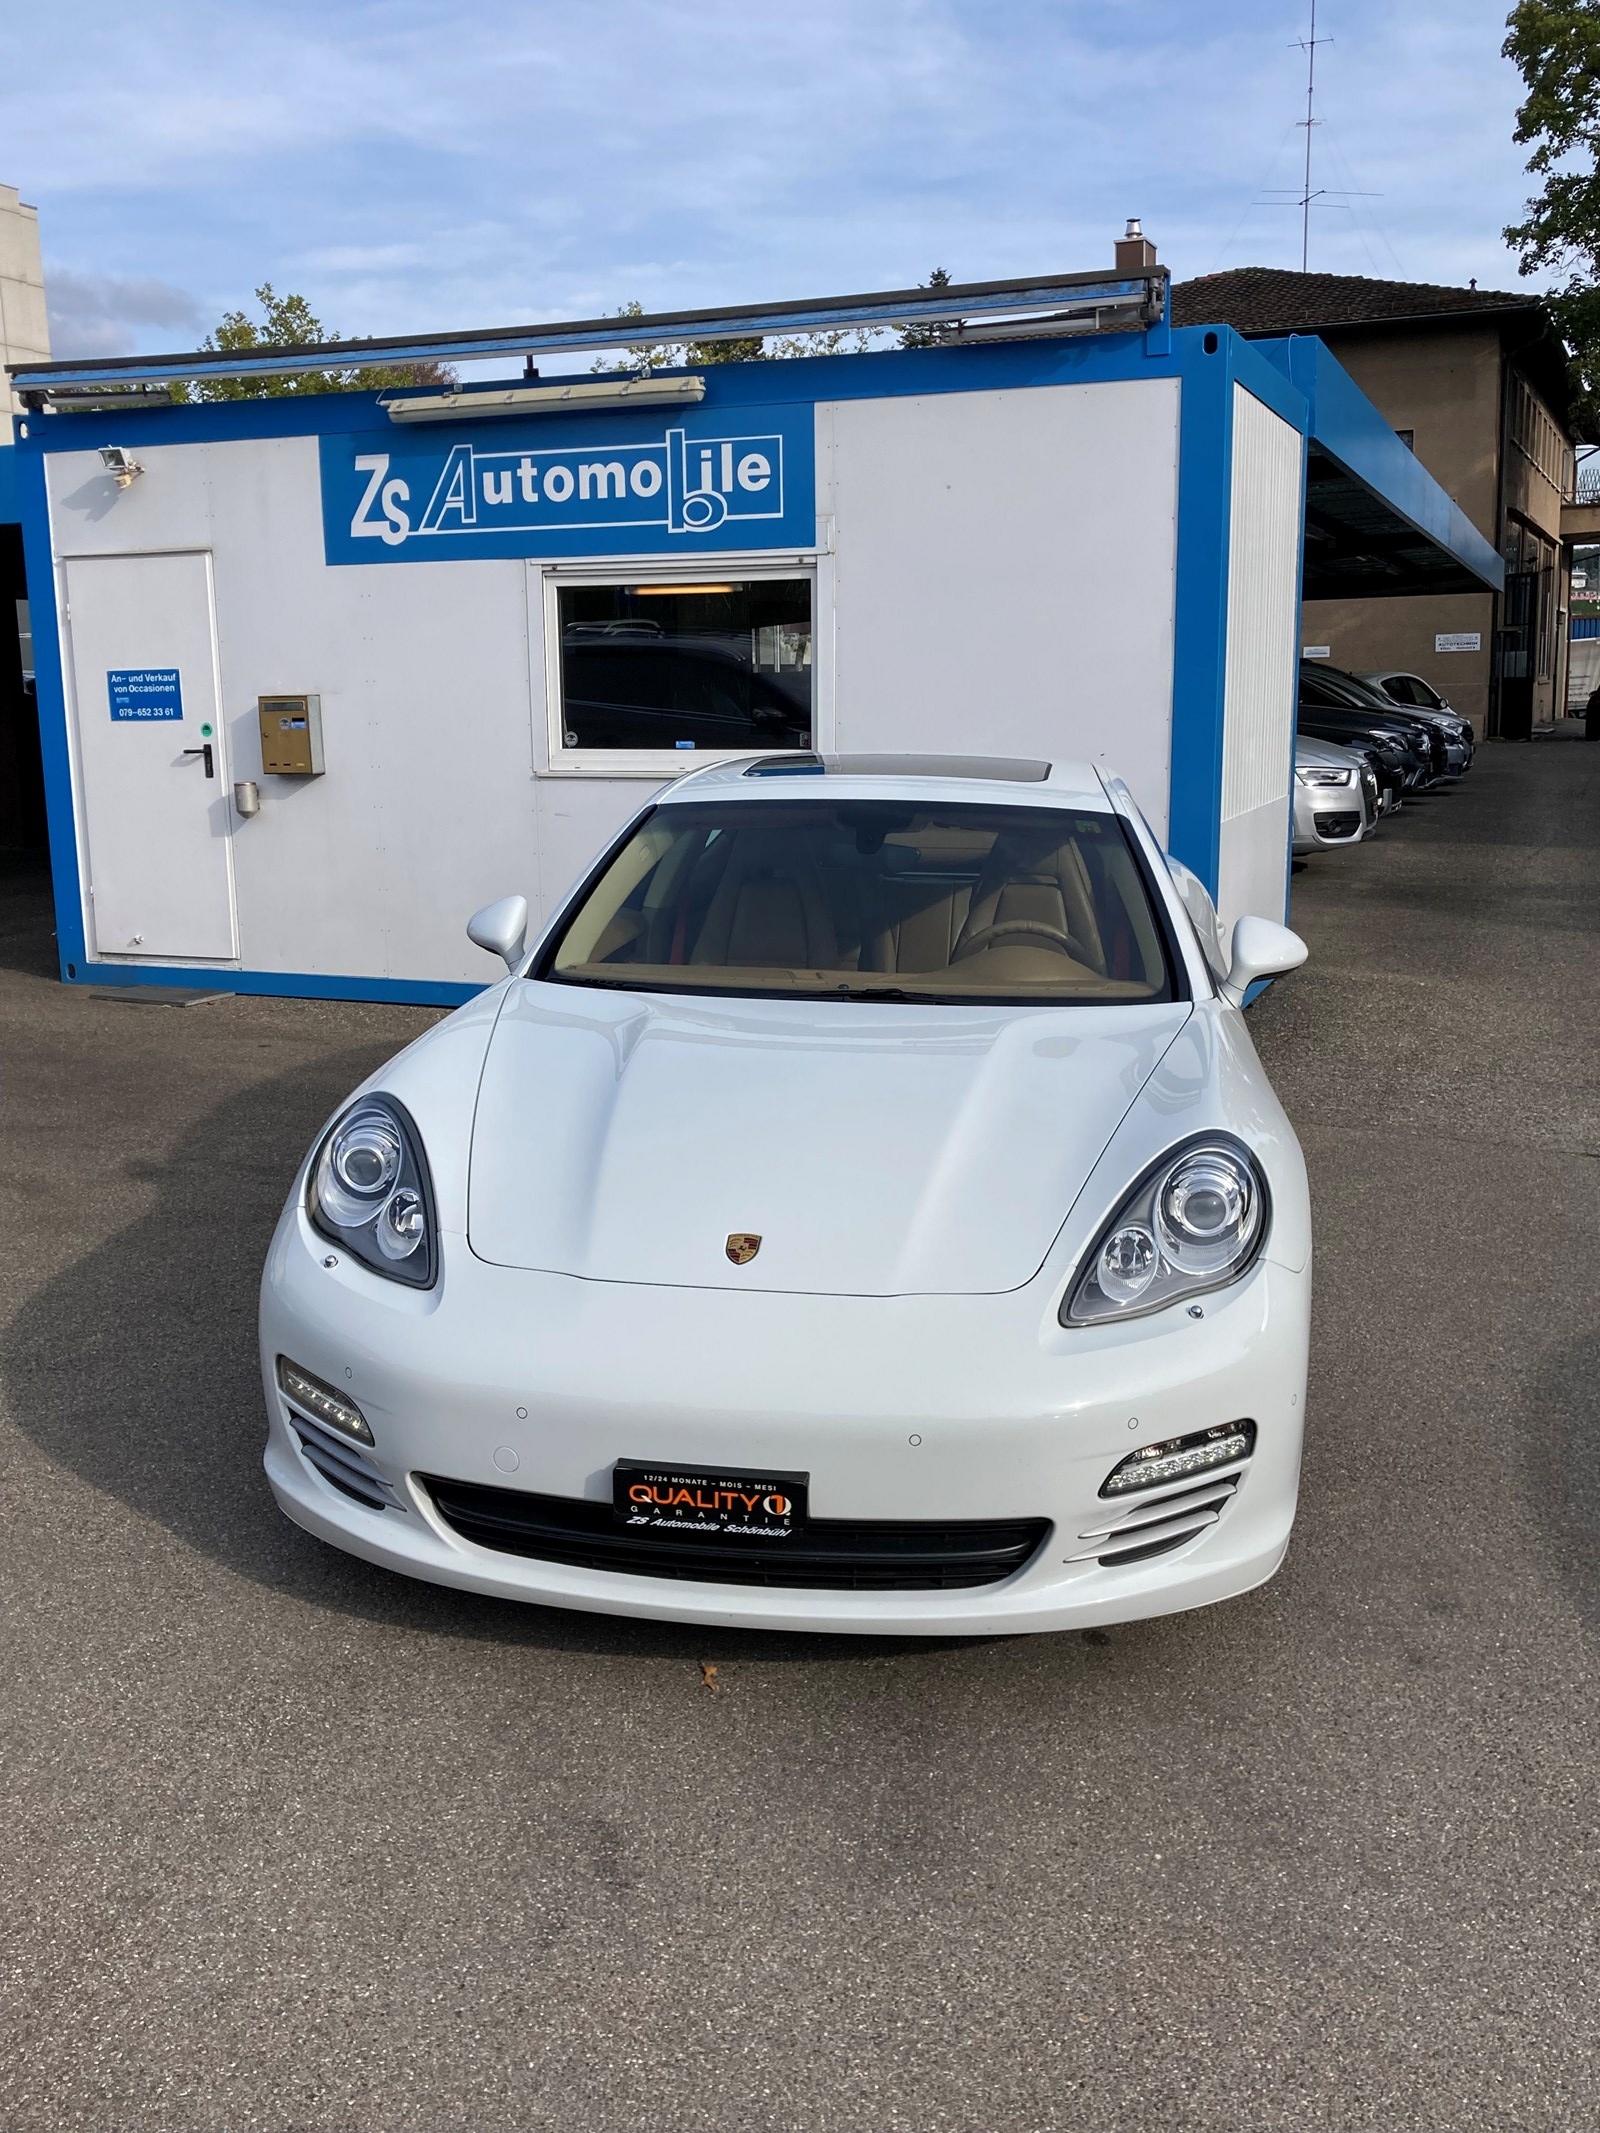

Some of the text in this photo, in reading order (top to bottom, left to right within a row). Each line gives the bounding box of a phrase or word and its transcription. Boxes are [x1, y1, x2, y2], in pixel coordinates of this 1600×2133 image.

[418, 428, 772, 534] Automobile
[111, 673, 176, 683] An- und Verkauf
[128, 684, 175, 693] Occasionen
[153, 708, 163, 716] 33
[164, 708, 174, 716] 61
[643, 1475, 668, 1483] 12/24
[671, 1477, 708, 1486] MONATE
[719, 1481, 742, 1489] MOIS
[629, 1485, 760, 1511] QUALITY
[630, 1506, 790, 1525] GARANTIE
[626, 1516, 792, 1537] ZS Automobile Schönbühl
